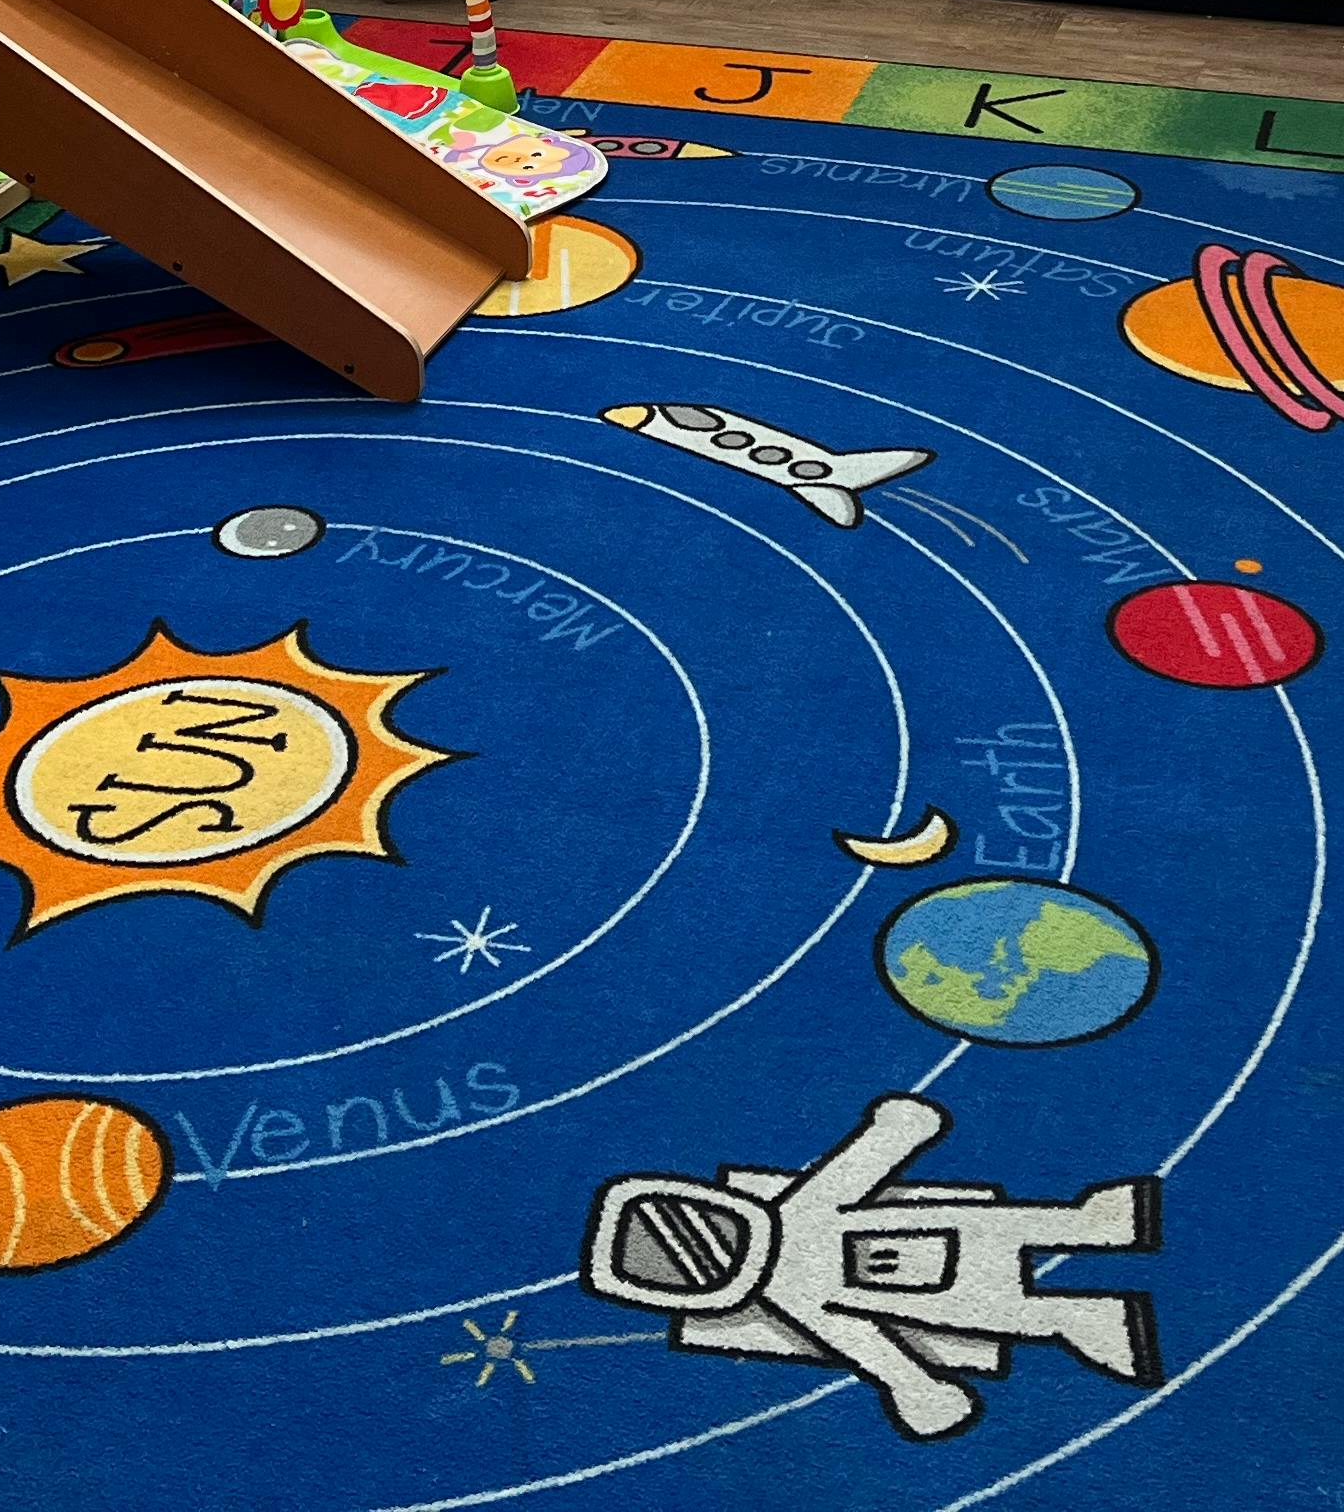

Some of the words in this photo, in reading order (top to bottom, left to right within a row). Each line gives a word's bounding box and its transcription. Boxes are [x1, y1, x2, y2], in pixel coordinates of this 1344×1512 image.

[694, 62, 812, 106] J
[963, 82, 1067, 135] K
[902, 228, 1136, 300] Saturn
[623, 285, 868, 351] Jupiter
[1016, 486, 1175, 585] Mars
[334, 524, 628, 653] Mercury
[67, 689, 289, 846] SUN
[952, 717, 1066, 872] Earth
[173, 1061, 522, 1193] Venus
